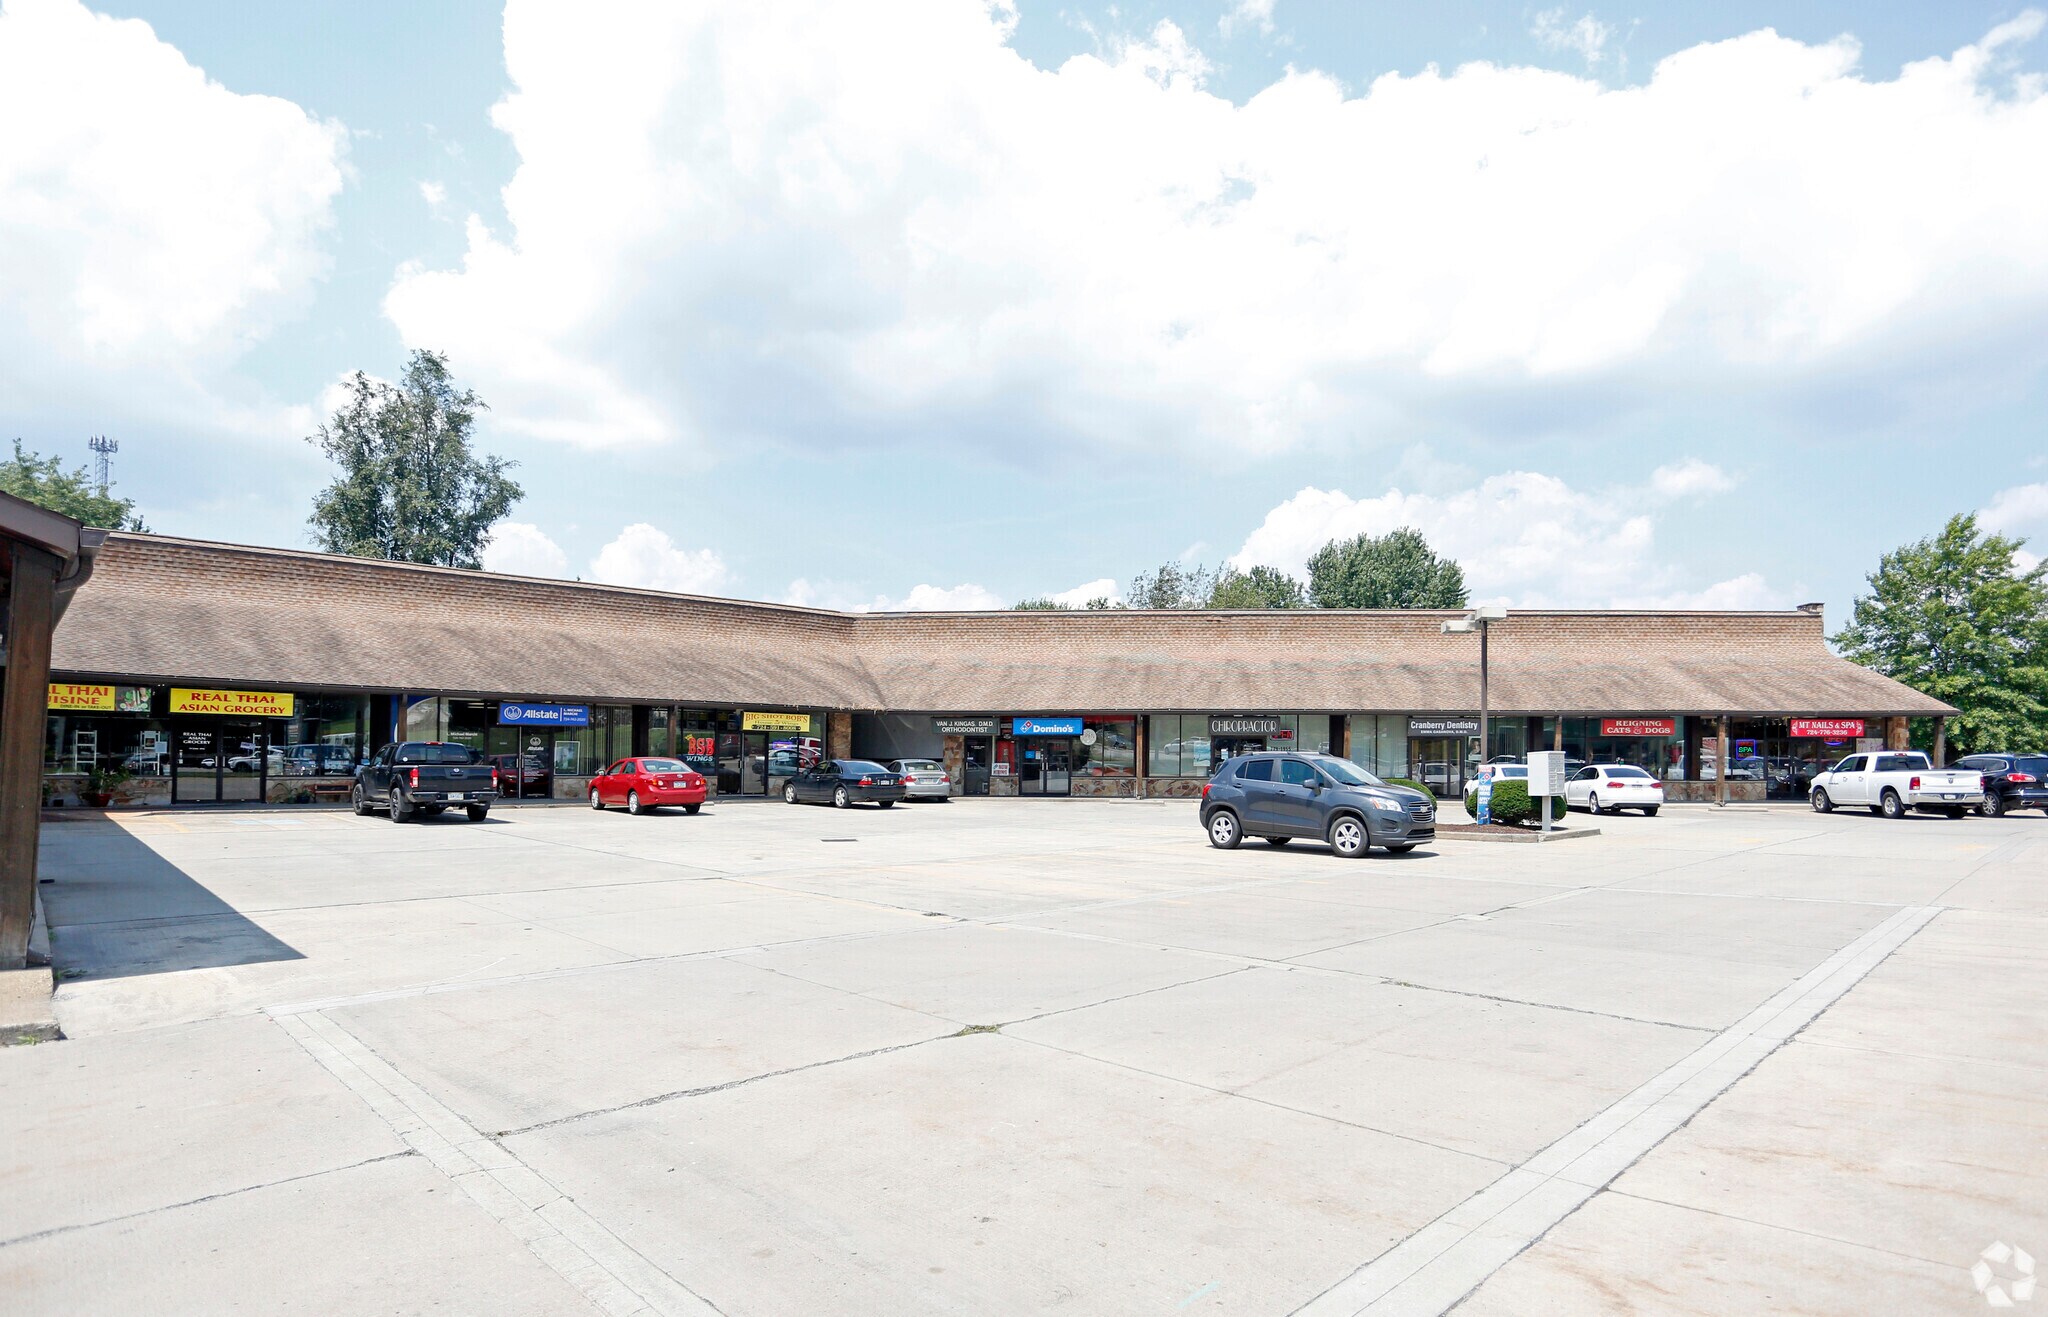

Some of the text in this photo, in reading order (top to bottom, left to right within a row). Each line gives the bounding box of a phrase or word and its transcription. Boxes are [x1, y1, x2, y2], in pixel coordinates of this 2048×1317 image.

[66, 686, 109, 696] THAI
[191, 692, 275, 704] REAL THAI
[179, 704, 285, 714] ASIAN GROCERY
[523, 709, 559, 719] Allstate
[745, 713, 760, 721] BIG
[786, 715, 808, 723] BOB'S
[1033, 725, 1073, 733] Domino's
[1211, 720, 1277, 732] CHIROPRACTOR
[1410, 721, 1478, 730] Cranberry Dentistry
[687, 737, 715, 756] BSB
